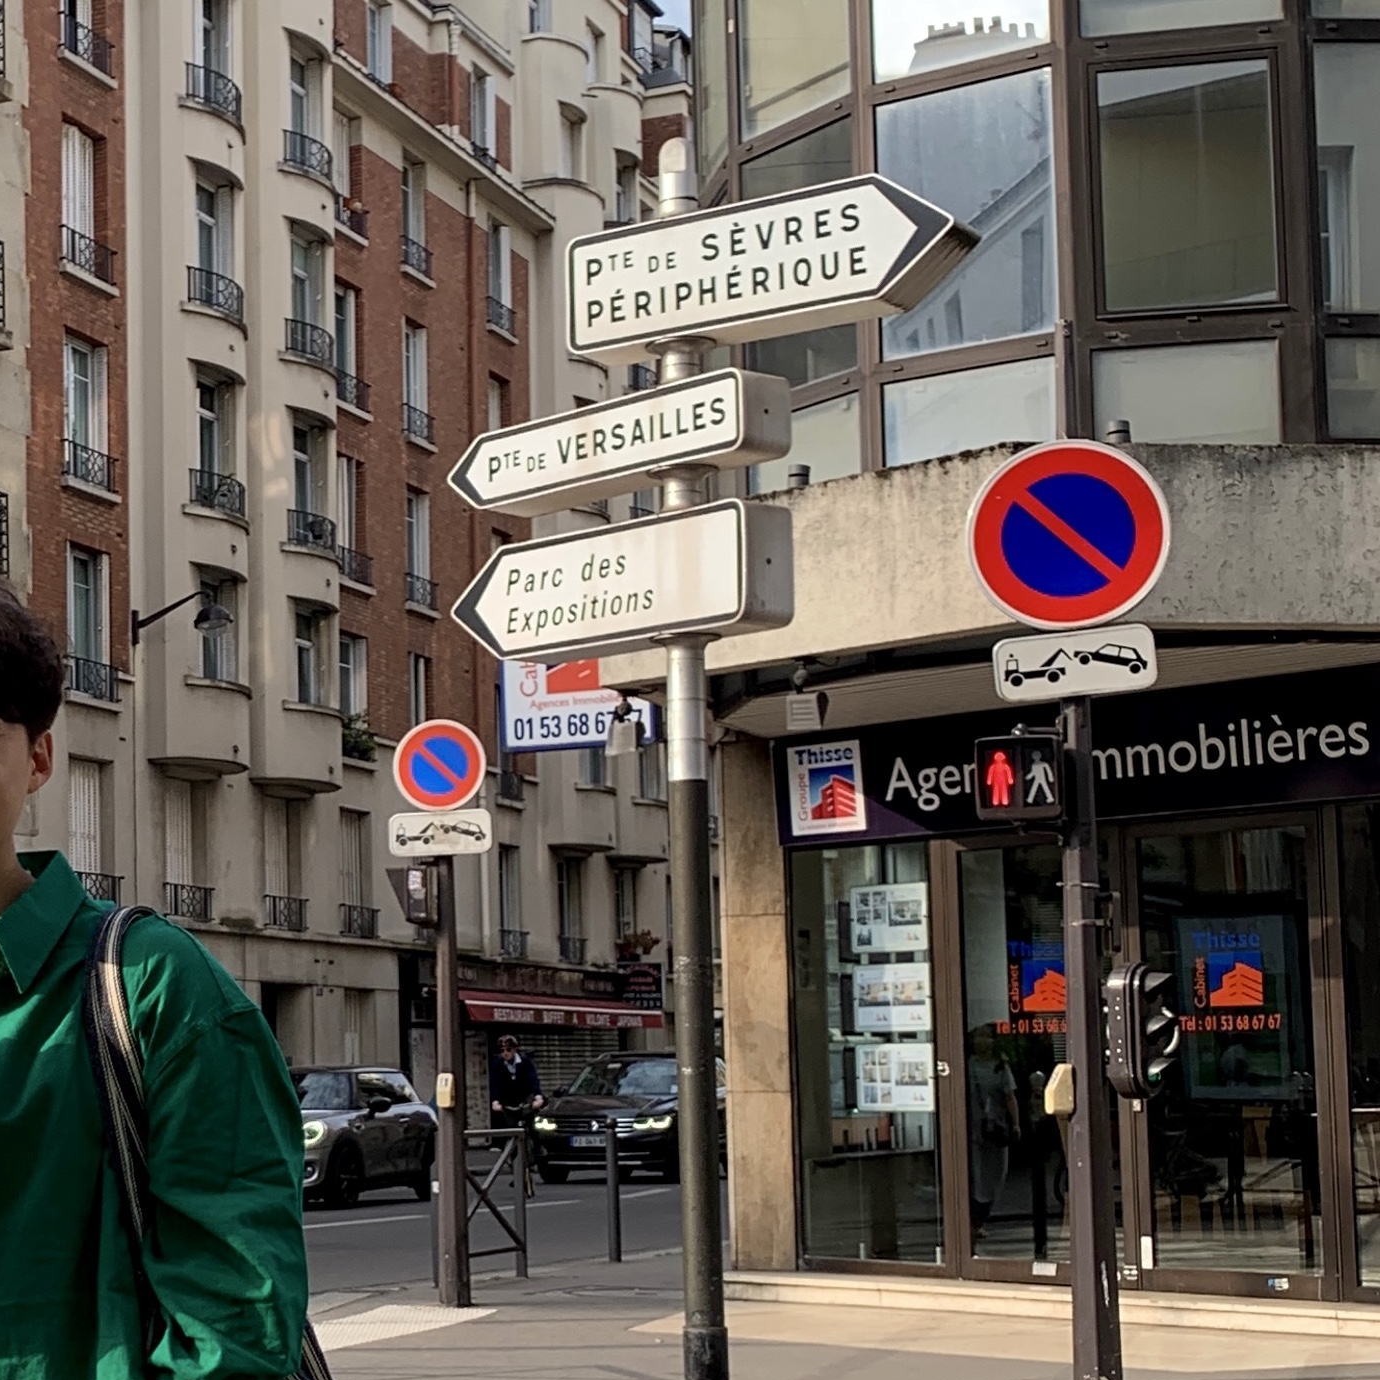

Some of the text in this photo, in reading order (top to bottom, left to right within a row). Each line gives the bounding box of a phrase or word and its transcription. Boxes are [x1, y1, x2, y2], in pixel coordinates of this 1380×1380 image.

[648, 252, 676, 273] DE
[701, 203, 860, 261] SÈVRES
[587, 246, 867, 327] PÉRIPHÉRIQUE
[527, 453, 546, 473] DE
[557, 398, 726, 464] VERSAILLES
[506, 553, 626, 596] Parc des
[506, 588, 654, 637] Expositions
[514, 717, 533, 740] 01
[540, 715, 562, 738] 53
[567, 713, 589, 736] 68
[529, 696, 569, 711] Agences
[795, 746, 854, 765] Thisse
[1092, 714, 1370, 780] mmobilières
[798, 773, 808, 821] Groupe
[1192, 931, 1261, 949] Thisse
[1009, 964, 1020, 1013] Cabinet
[1194, 956, 1207, 1009] Cabinet
[1018, 1019, 1029, 1034] 01
[1205, 1014, 1217, 1030] 01
[1221, 1014, 1233, 1030] 53
[1236, 1014, 1249, 1030] 68
[1252, 1013, 1265, 1030] 67
[1268, 1013, 1281, 1030] 67
